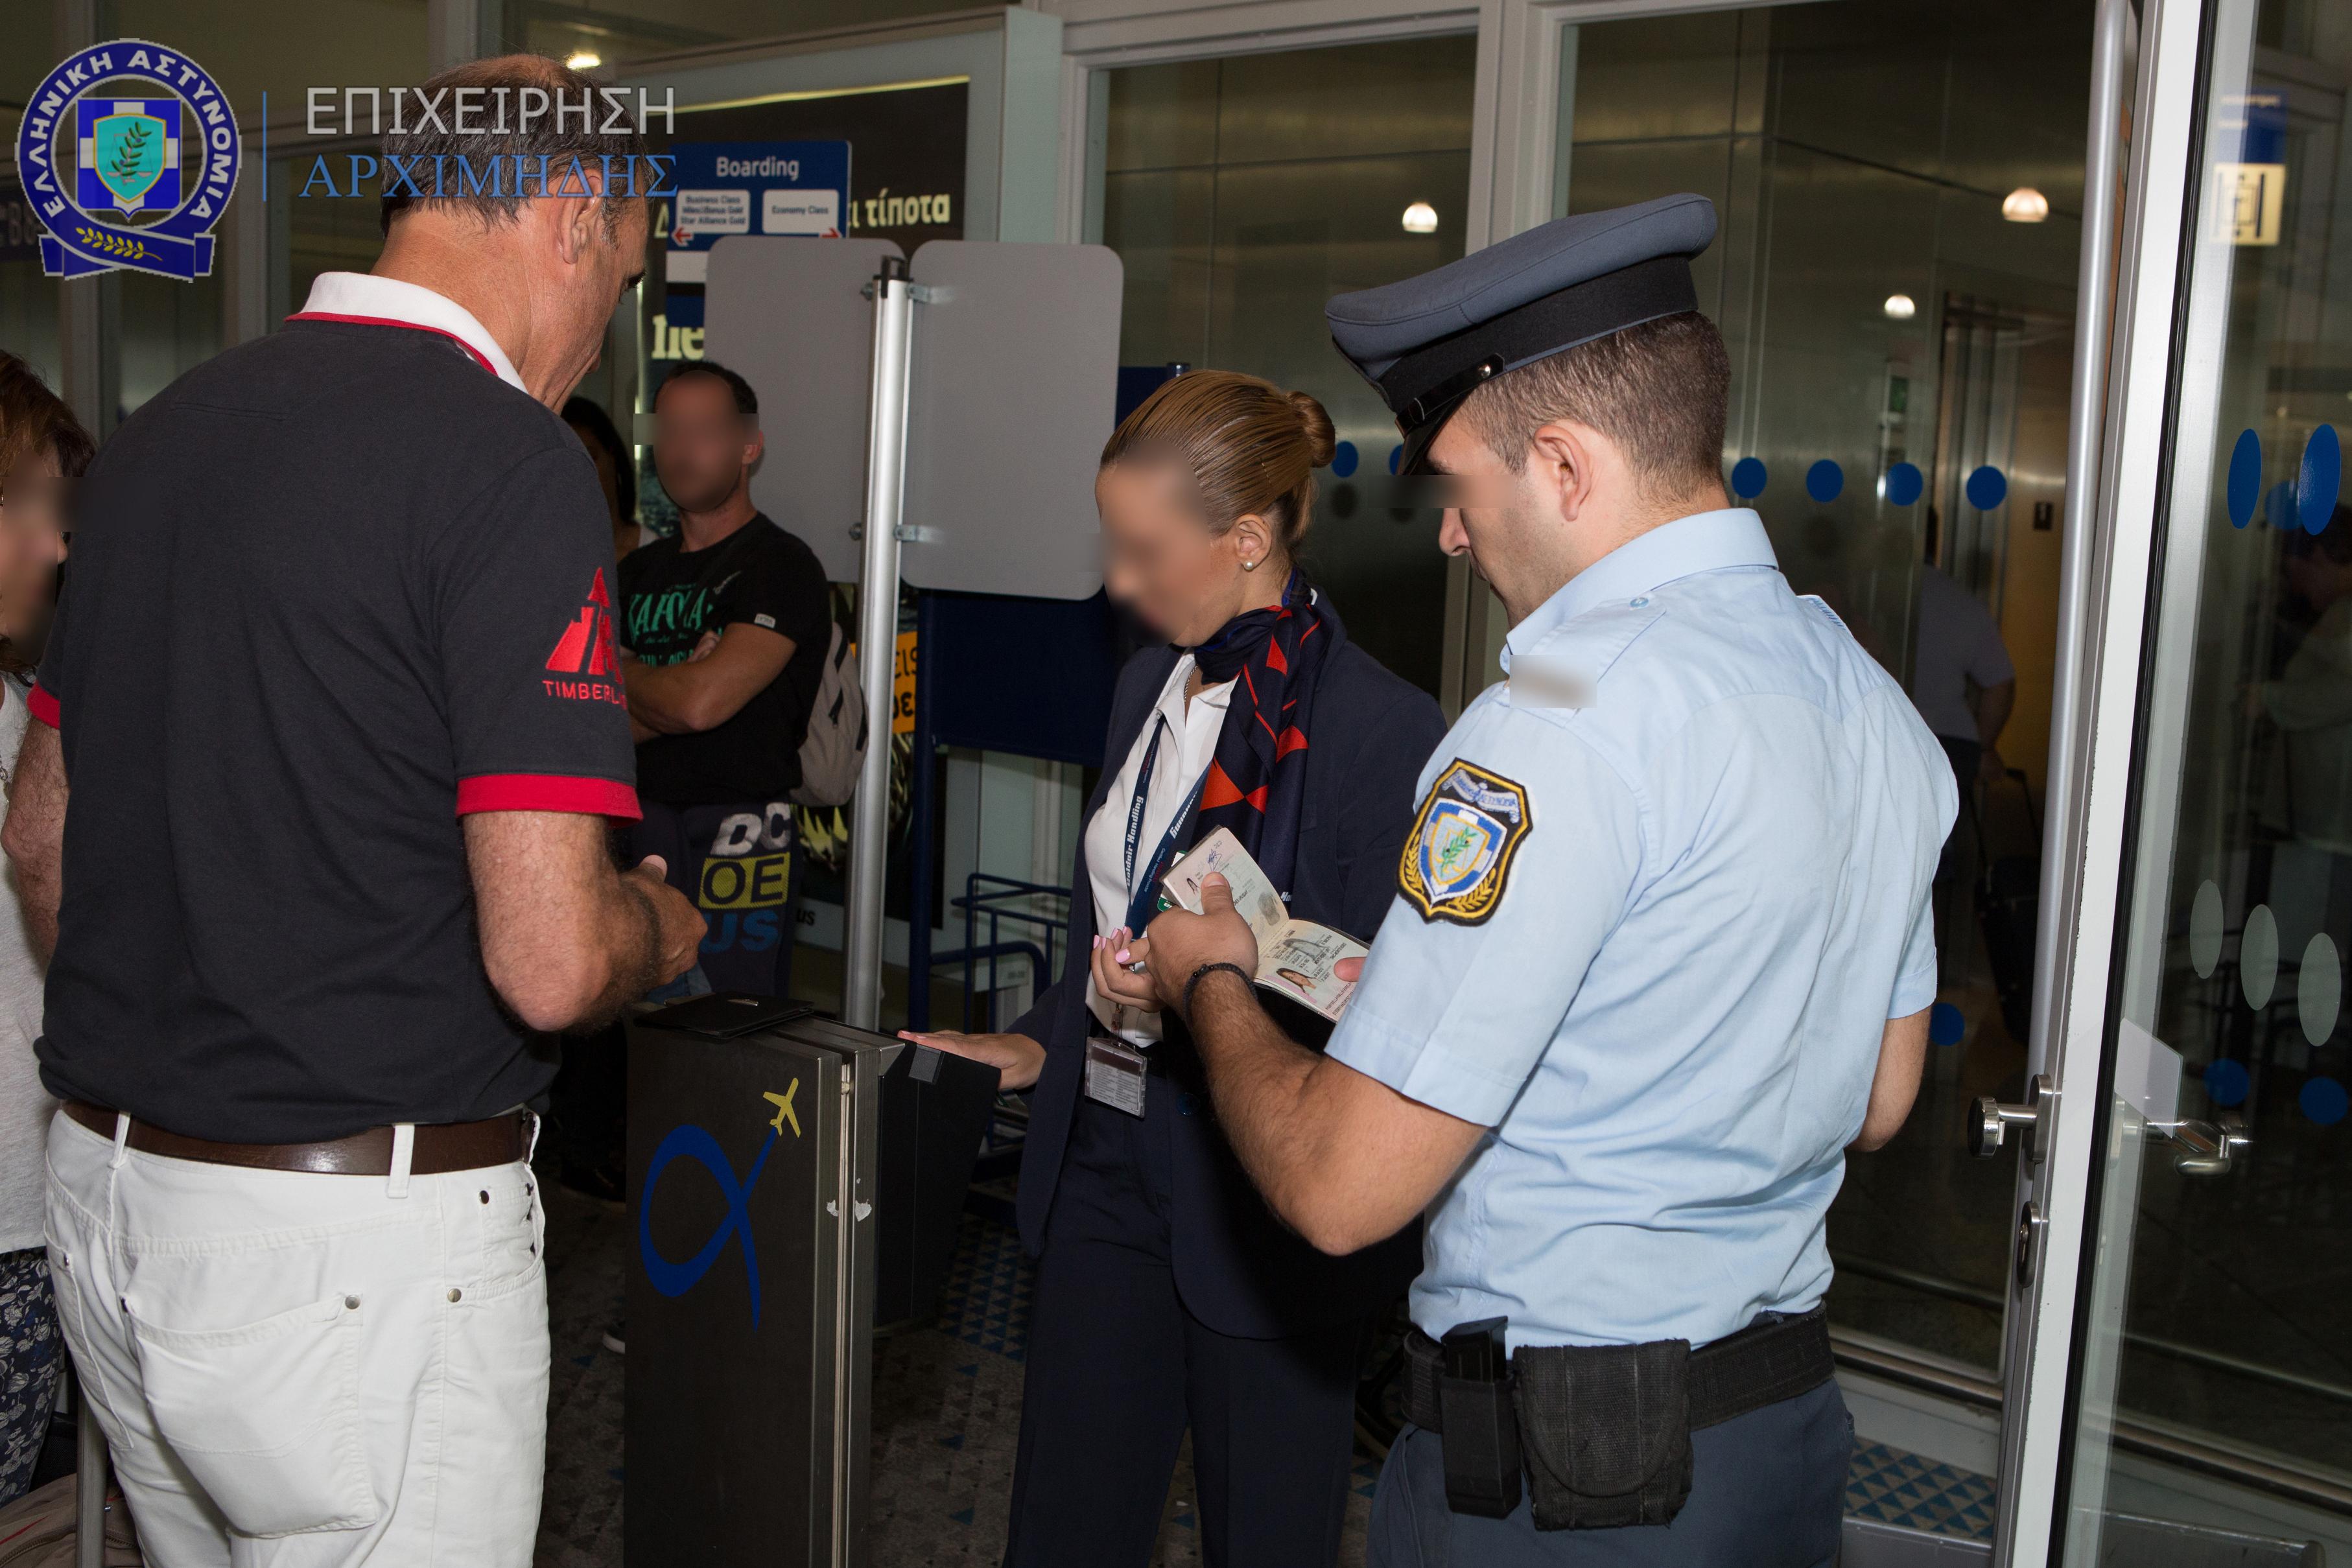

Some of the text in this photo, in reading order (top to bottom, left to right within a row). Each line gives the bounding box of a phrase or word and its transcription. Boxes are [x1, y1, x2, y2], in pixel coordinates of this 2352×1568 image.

[716, 156, 799, 181] Boarding
[685, 195, 740, 204] Business Class
[771, 204, 829, 215] Economy Class
[865, 187, 951, 228] τίποτα
[710, 802, 791, 856] DC
[1127, 795, 1144, 843] Handling
[703, 857, 785, 905] OE
